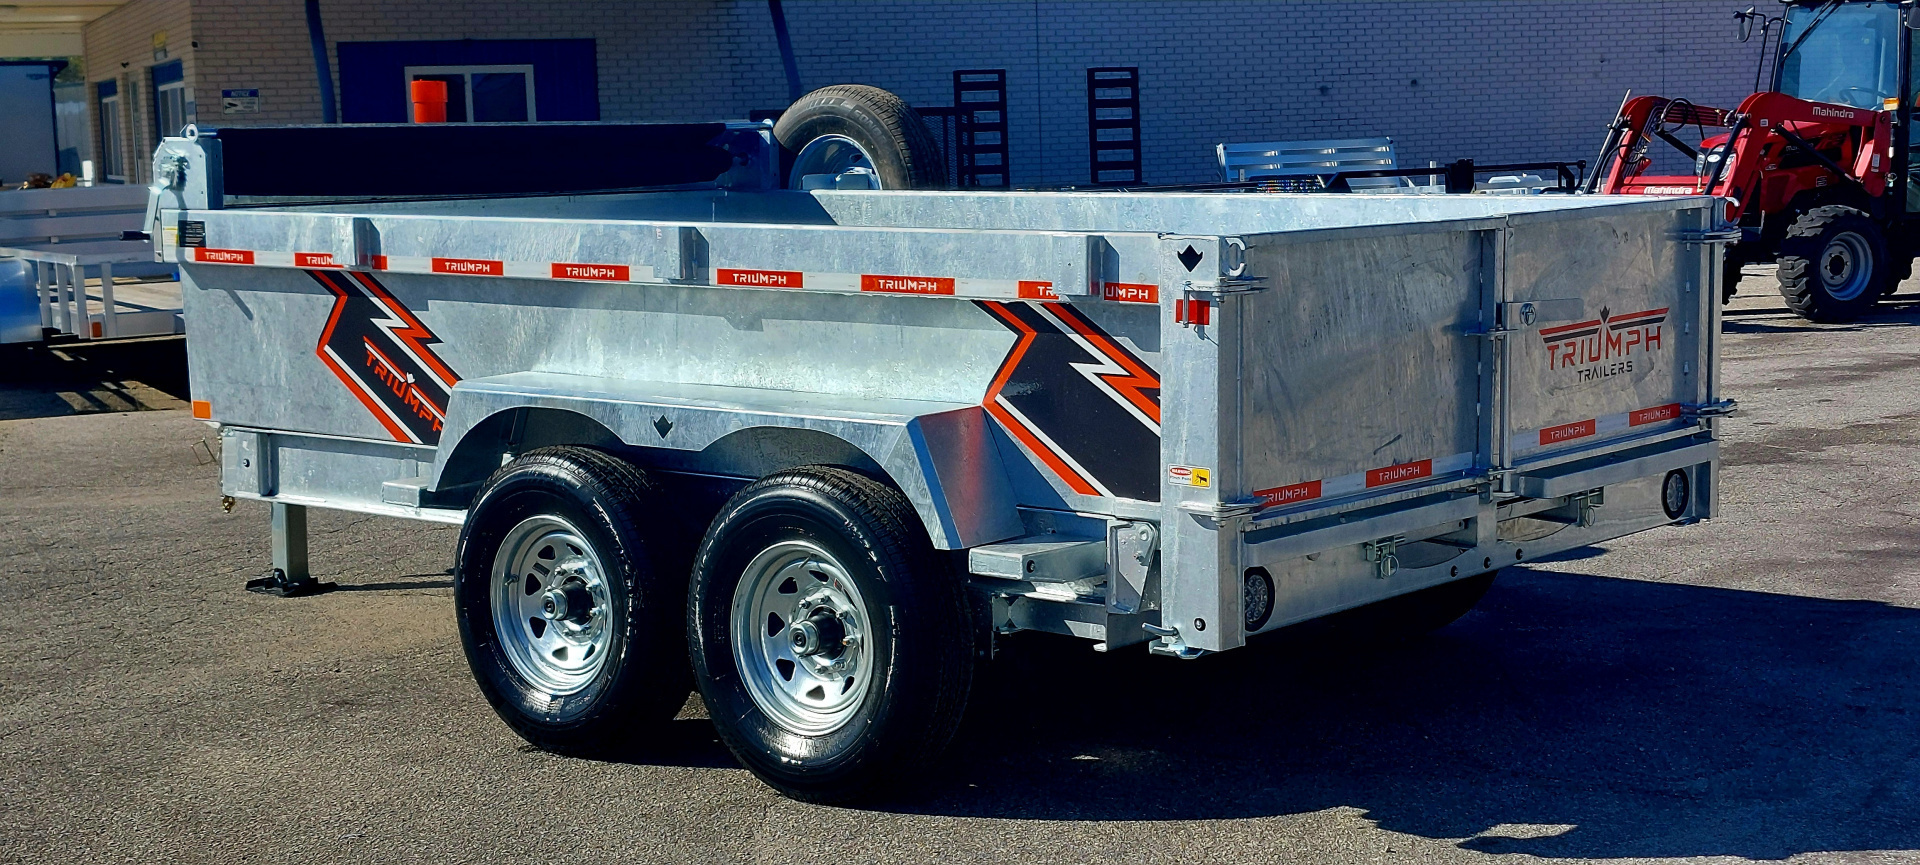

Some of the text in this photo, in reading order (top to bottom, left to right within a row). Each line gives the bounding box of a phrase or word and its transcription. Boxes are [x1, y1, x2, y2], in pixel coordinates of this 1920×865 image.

[1812, 106, 1854, 119] Mahindra
[1643, 186, 1693, 195] Mahindra
[205, 251, 244, 262] TRIUMPH
[444, 261, 490, 273] TRIUMPH
[566, 266, 615, 278] TRIUMPH
[732, 272, 787, 285] TRIUMPH
[878, 278, 937, 292] TRIUMPH
[1546, 326, 1662, 371] TRIUMPH
[1577, 360, 1633, 383] TRAILERS
[1638, 408, 1671, 422] TRIUMPH
[1550, 426, 1586, 440] TRIUMPH
[1378, 465, 1420, 482] TRIUMPH
